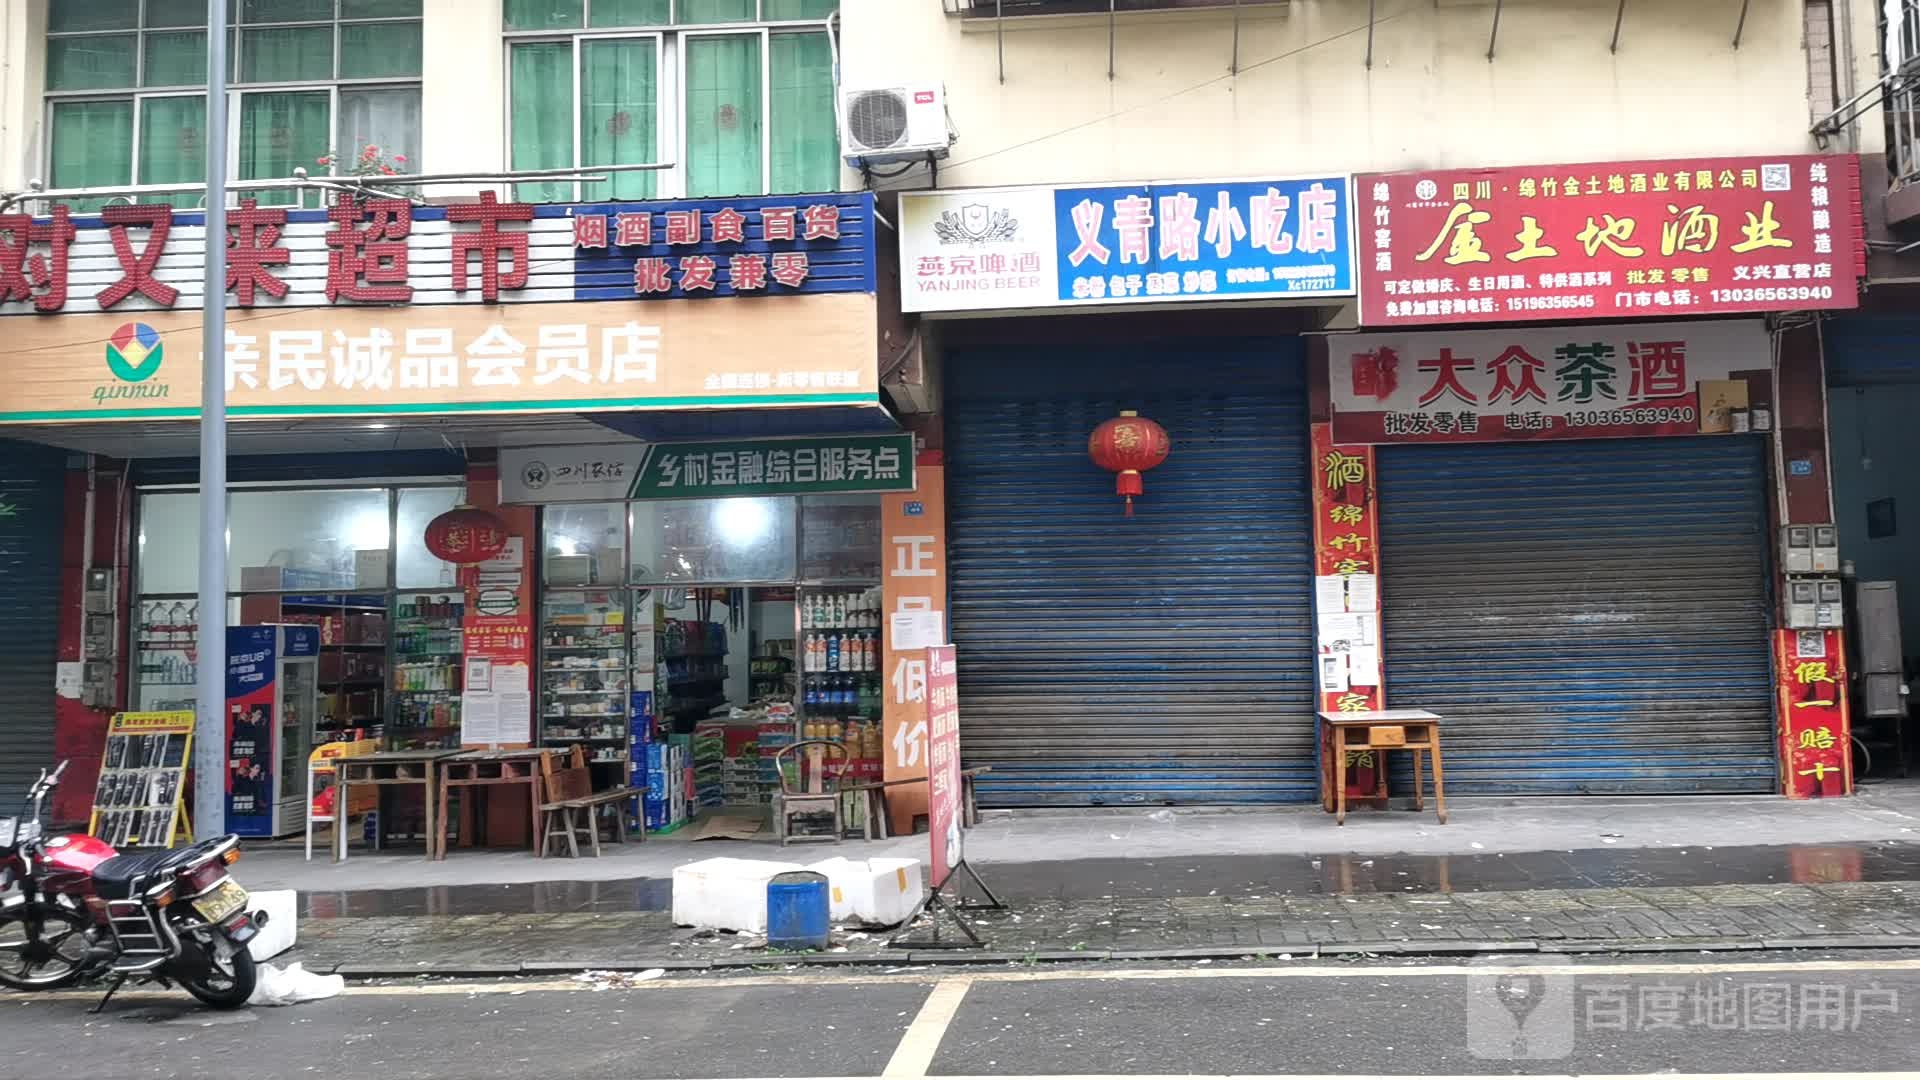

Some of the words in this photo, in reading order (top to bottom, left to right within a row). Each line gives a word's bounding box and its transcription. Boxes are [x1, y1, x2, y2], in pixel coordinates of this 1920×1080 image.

[1068, 182, 1337, 267] 义青路小吃店
[1372, 182, 1392, 272] 绵竹窖酒
[1809, 162, 1832, 254] 纯粮酿造
[1416, 201, 1793, 265] 金土地酒业
[634, 253, 808, 294] 批发兼零
[917, 251, 1041, 276] 燕京啤酒
[918, 278, 989, 291] YANJING
[995, 276, 1041, 289] BEER
[1733, 263, 1832, 281] 义兴直营店
[91, 378, 169, 405] qinmin
[1417, 340, 1687, 406] 大众茶酒
[1386, 410, 1478, 433] 批发零售
[657, 446, 901, 487] 乡村金融综合服务点
[1793, 661, 1840, 781] 假一赔十
